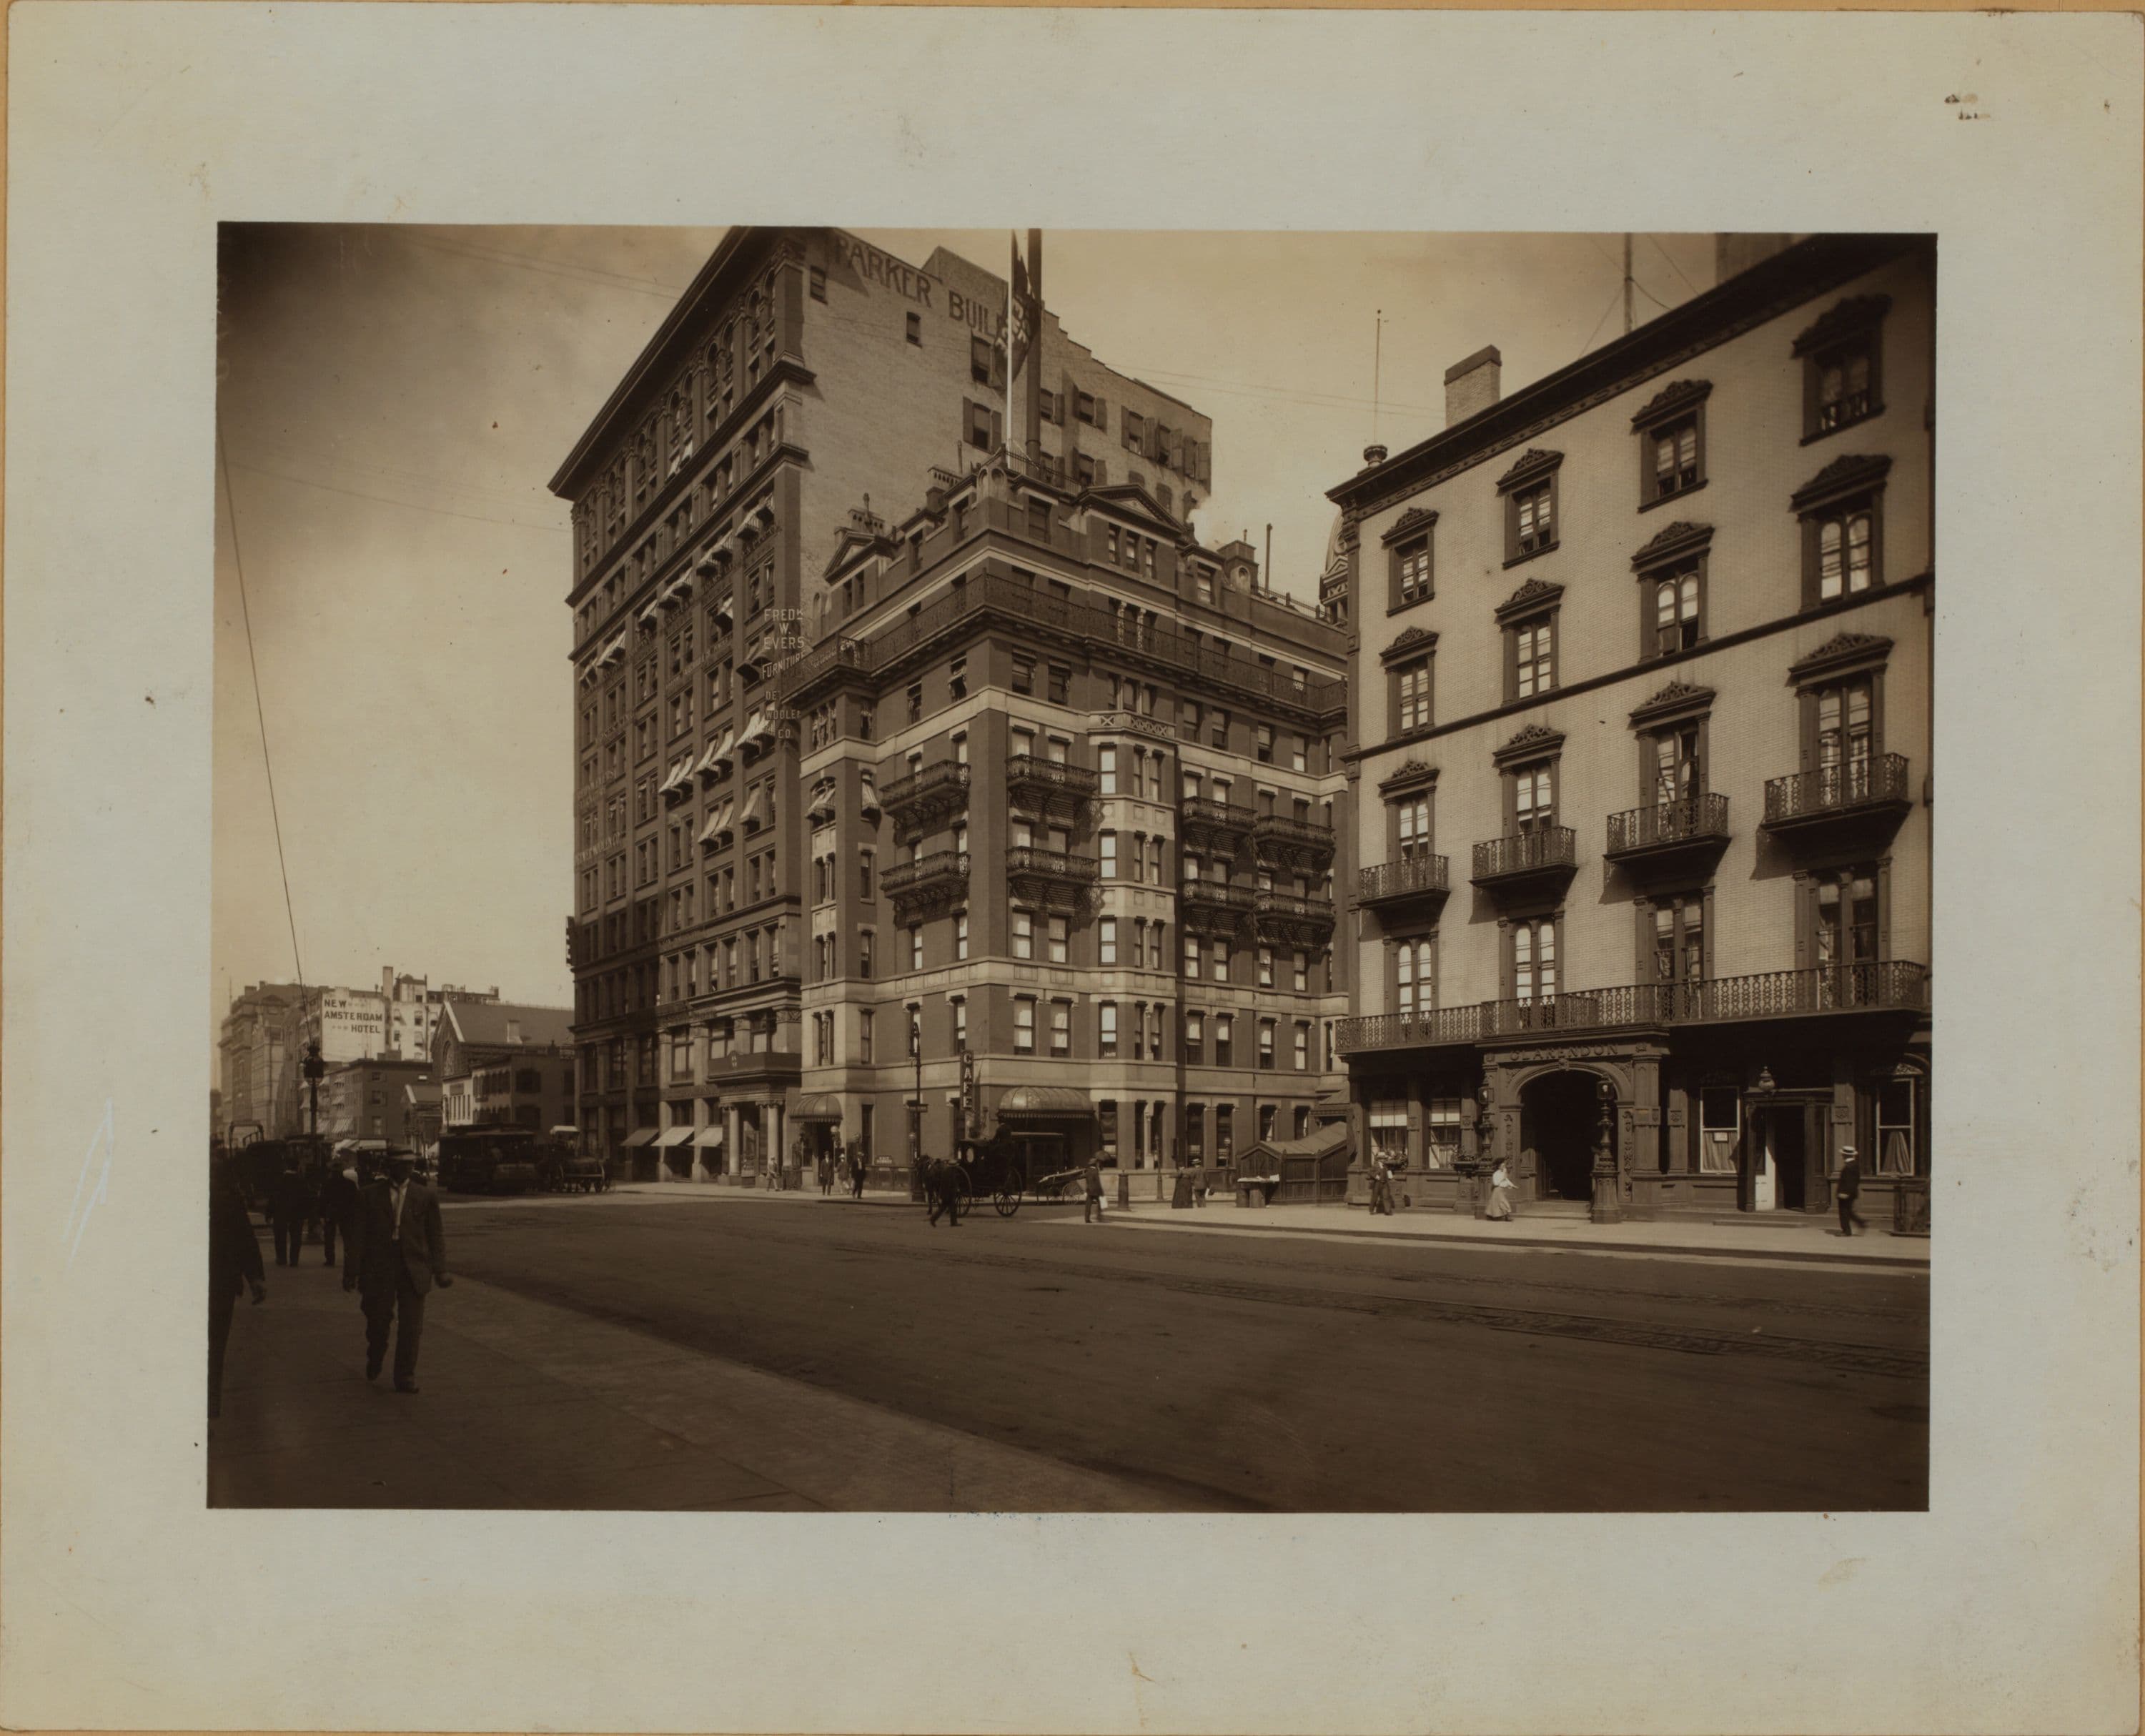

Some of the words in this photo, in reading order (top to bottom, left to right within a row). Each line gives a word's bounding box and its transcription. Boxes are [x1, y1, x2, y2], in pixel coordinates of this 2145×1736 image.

[834, 235, 932, 308] PARKER
[779, 623, 791, 635] W.
[763, 636, 805, 650] EVERS
[324, 999, 347, 1008] NEW
[324, 1011, 383, 1022] AMSTERDAM
[351, 1025, 381, 1033] HOTEL
[1510, 1045, 1619, 1061] CLARENDON
